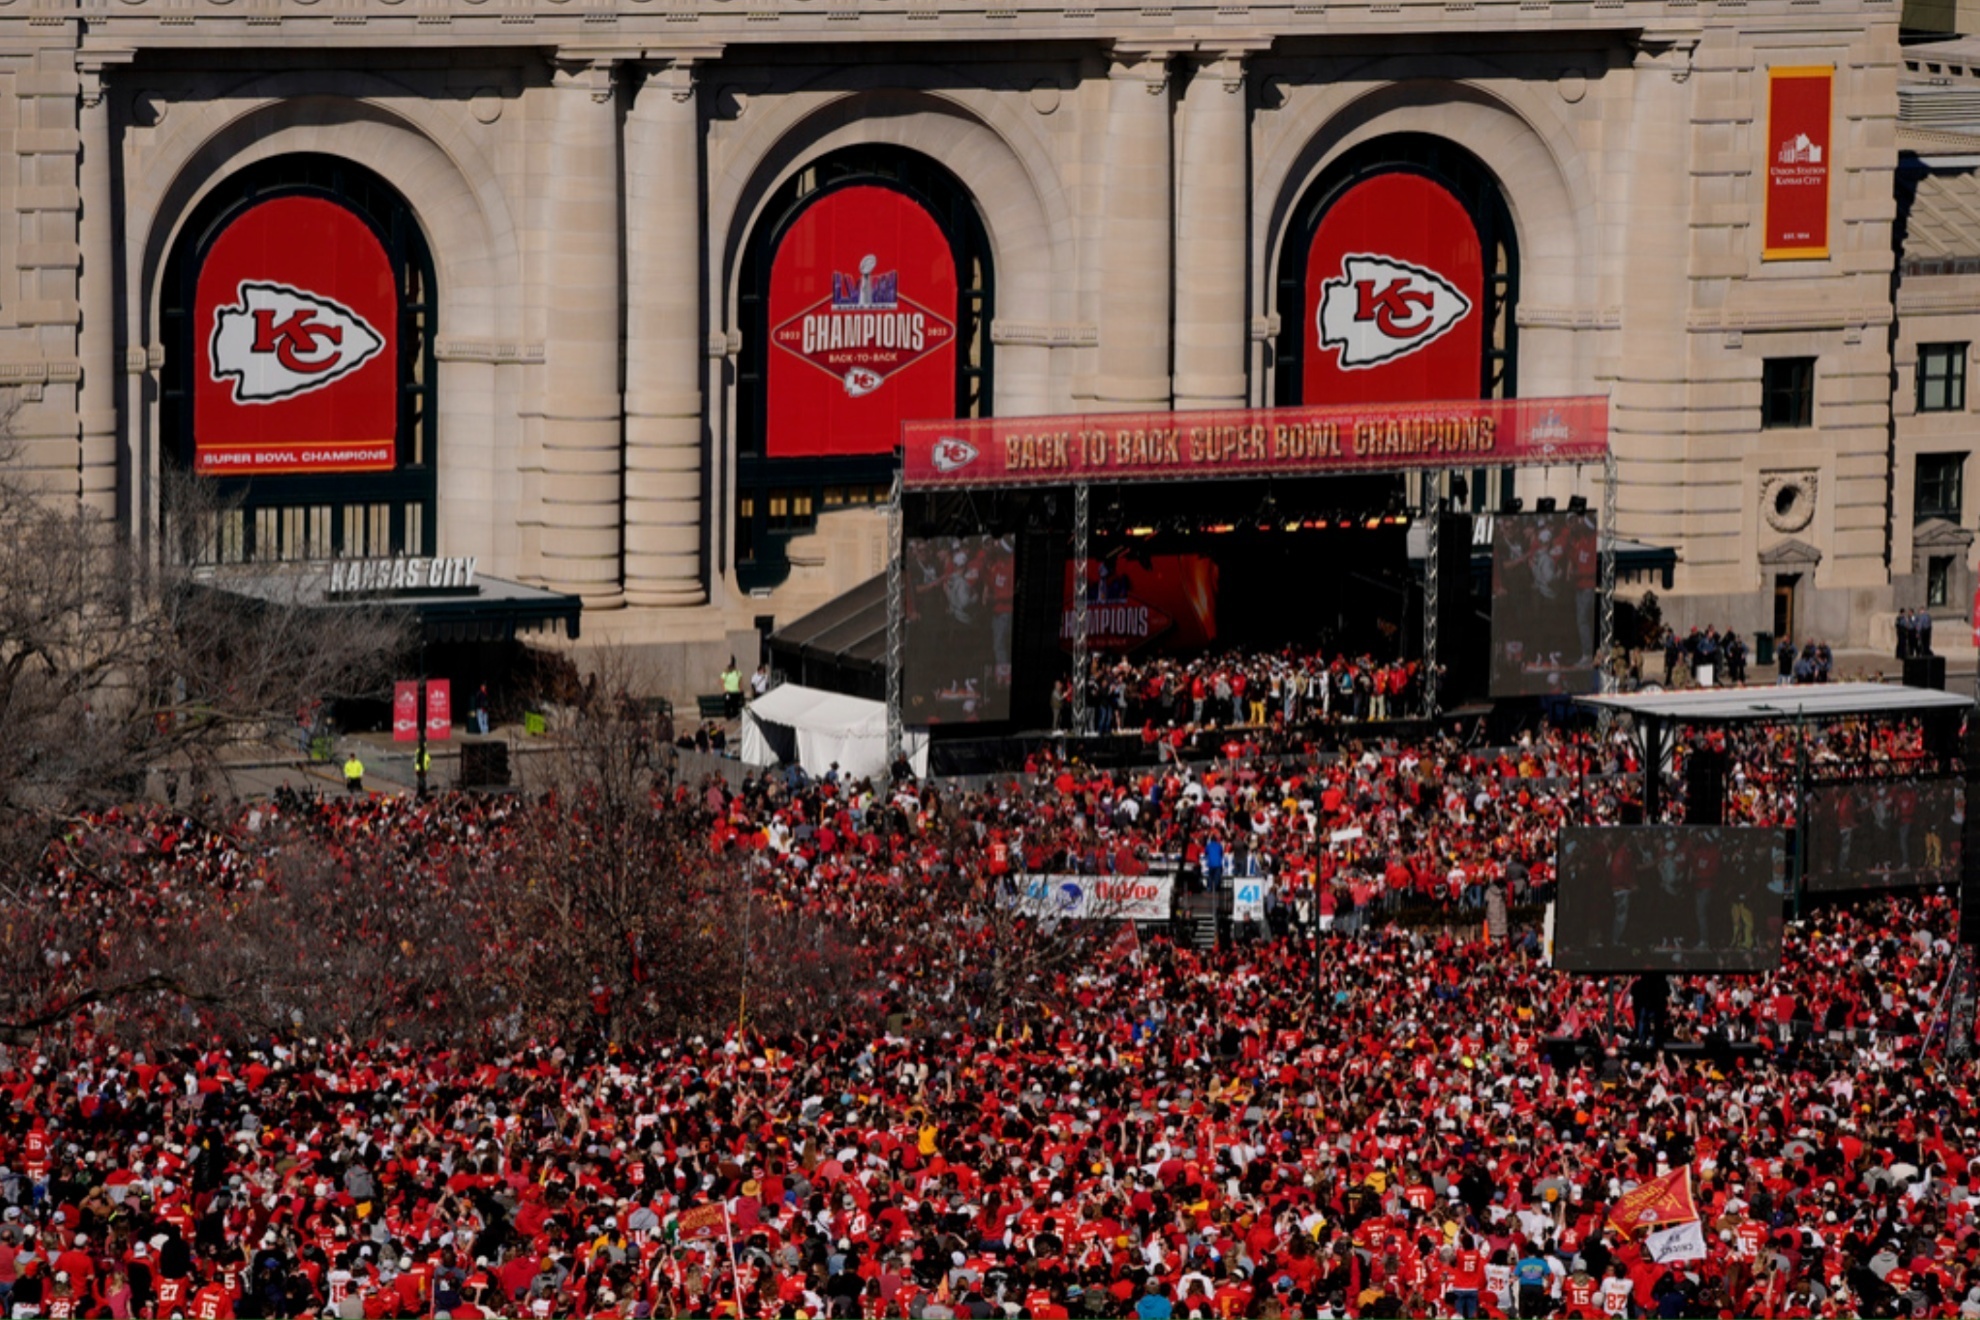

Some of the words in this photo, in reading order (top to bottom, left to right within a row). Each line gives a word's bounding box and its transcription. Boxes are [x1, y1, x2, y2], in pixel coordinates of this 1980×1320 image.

[1353, 277, 1435, 339] KC
[250, 309, 343, 374] KC
[802, 312, 925, 355] CHAMPIONS
[1189, 424, 1268, 464] SUPER
[1273, 421, 1342, 461] BOWL
[1353, 415, 1496, 456] CHAMPIONS
[204, 453, 251, 464] SUPER
[255, 452, 298, 463] BOWL
[302, 450, 387, 462] CHAMPIONS
[331, 558, 420, 592] KANSAS
[429, 556, 478, 587] CITY
[1238, 885, 1260, 904] 41
[160, 1283, 179, 1301] 27
[1573, 1290, 1589, 1305] 15
[1607, 1294, 1627, 1310] 87
